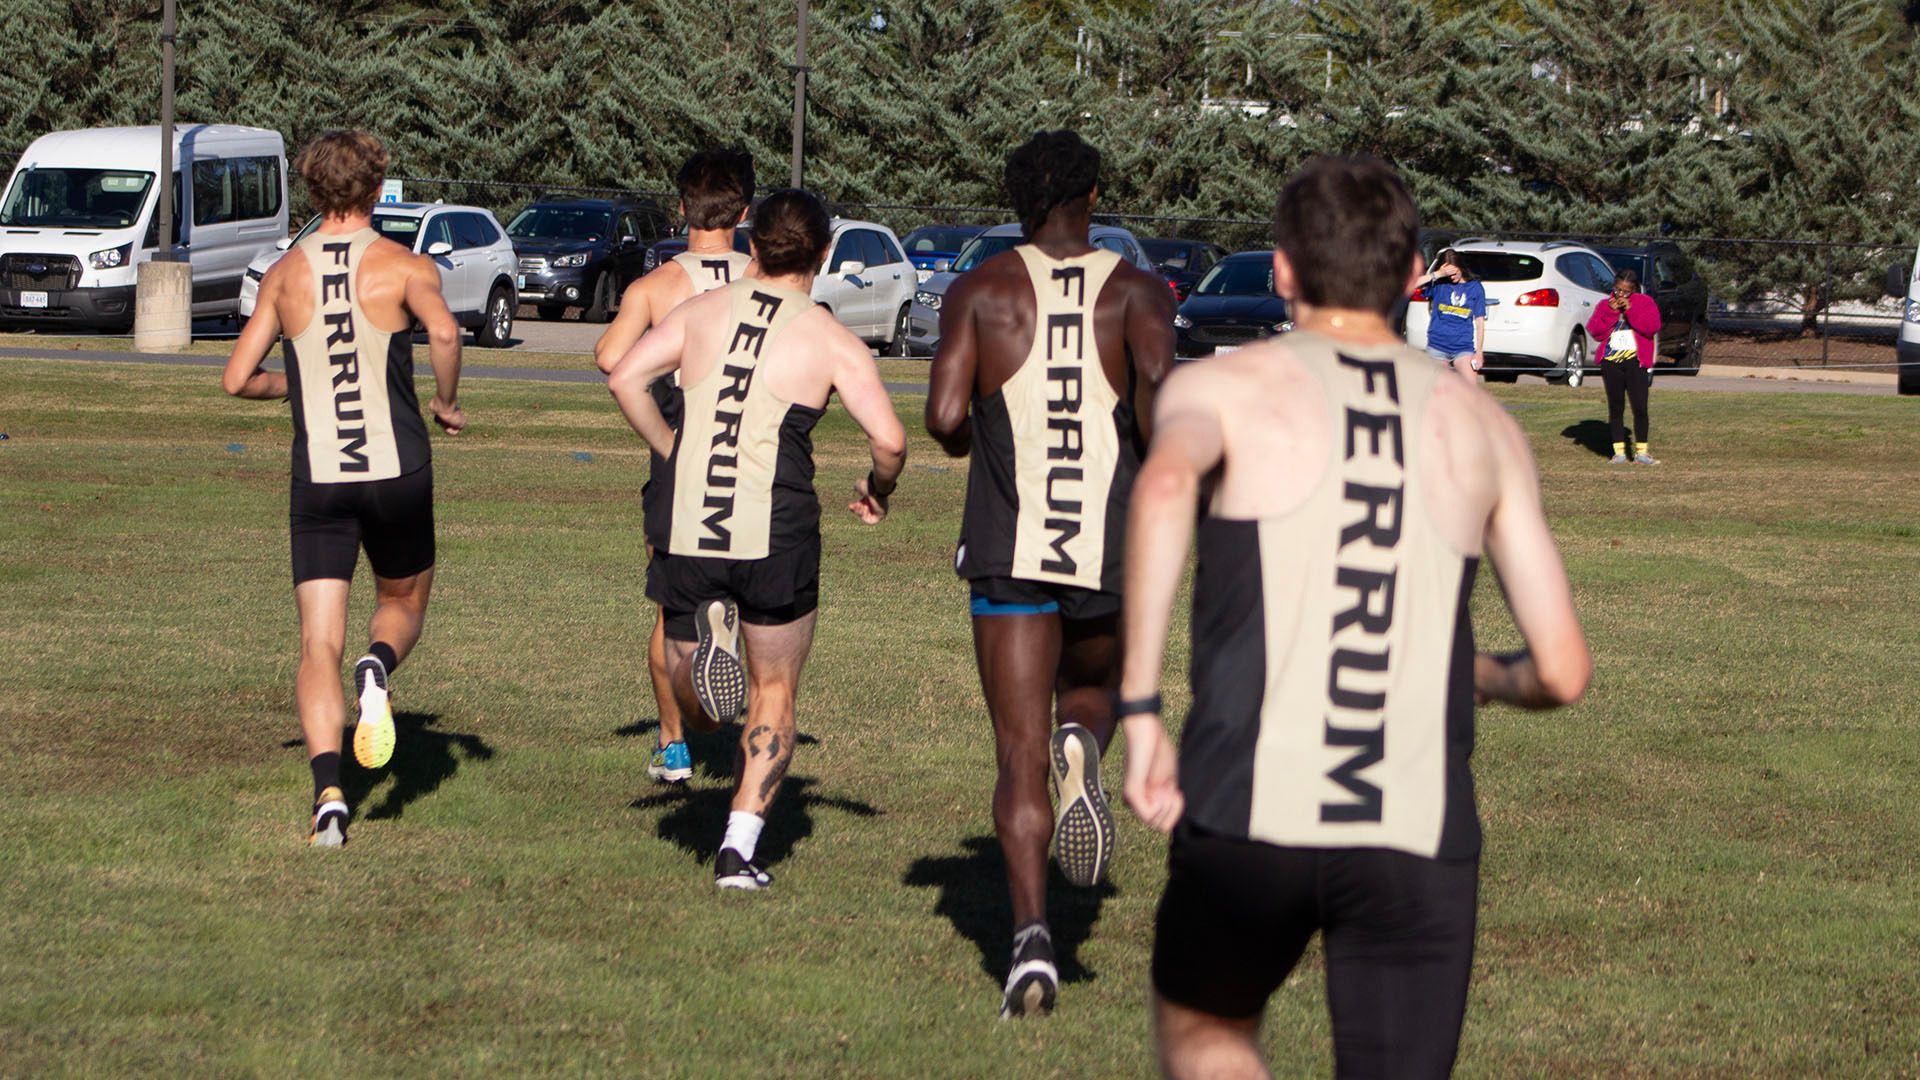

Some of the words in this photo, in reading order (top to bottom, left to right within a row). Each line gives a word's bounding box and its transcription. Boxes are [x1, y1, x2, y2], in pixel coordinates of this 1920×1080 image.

[322, 241, 370, 473] FERRUM
[698, 289, 784, 552] FERRUM
[1040, 266, 1085, 576] FERRUM
[1318, 350, 1405, 824] FERRUM
